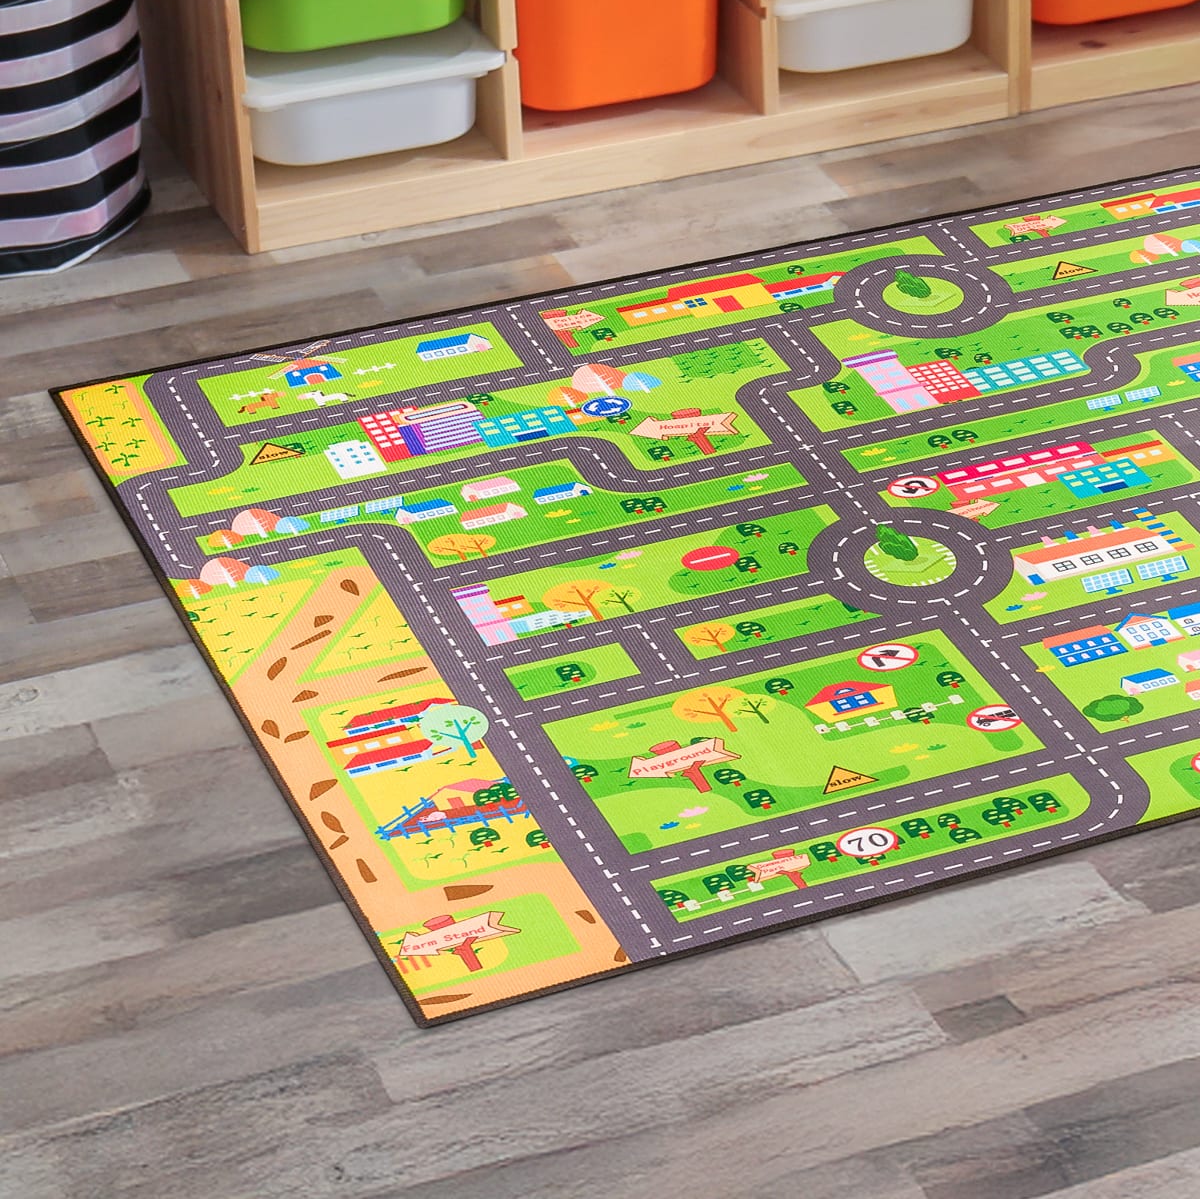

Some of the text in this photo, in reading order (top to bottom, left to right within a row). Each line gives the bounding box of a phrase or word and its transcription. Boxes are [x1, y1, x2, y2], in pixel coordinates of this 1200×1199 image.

[1058, 267, 1083, 275] slow
[659, 420, 715, 431] Hospital
[258, 450, 289, 460] slow
[632, 747, 713, 776] Playground
[829, 775, 862, 787] slow
[847, 832, 888, 852] 70
[402, 925, 486, 953] Farm Stand
